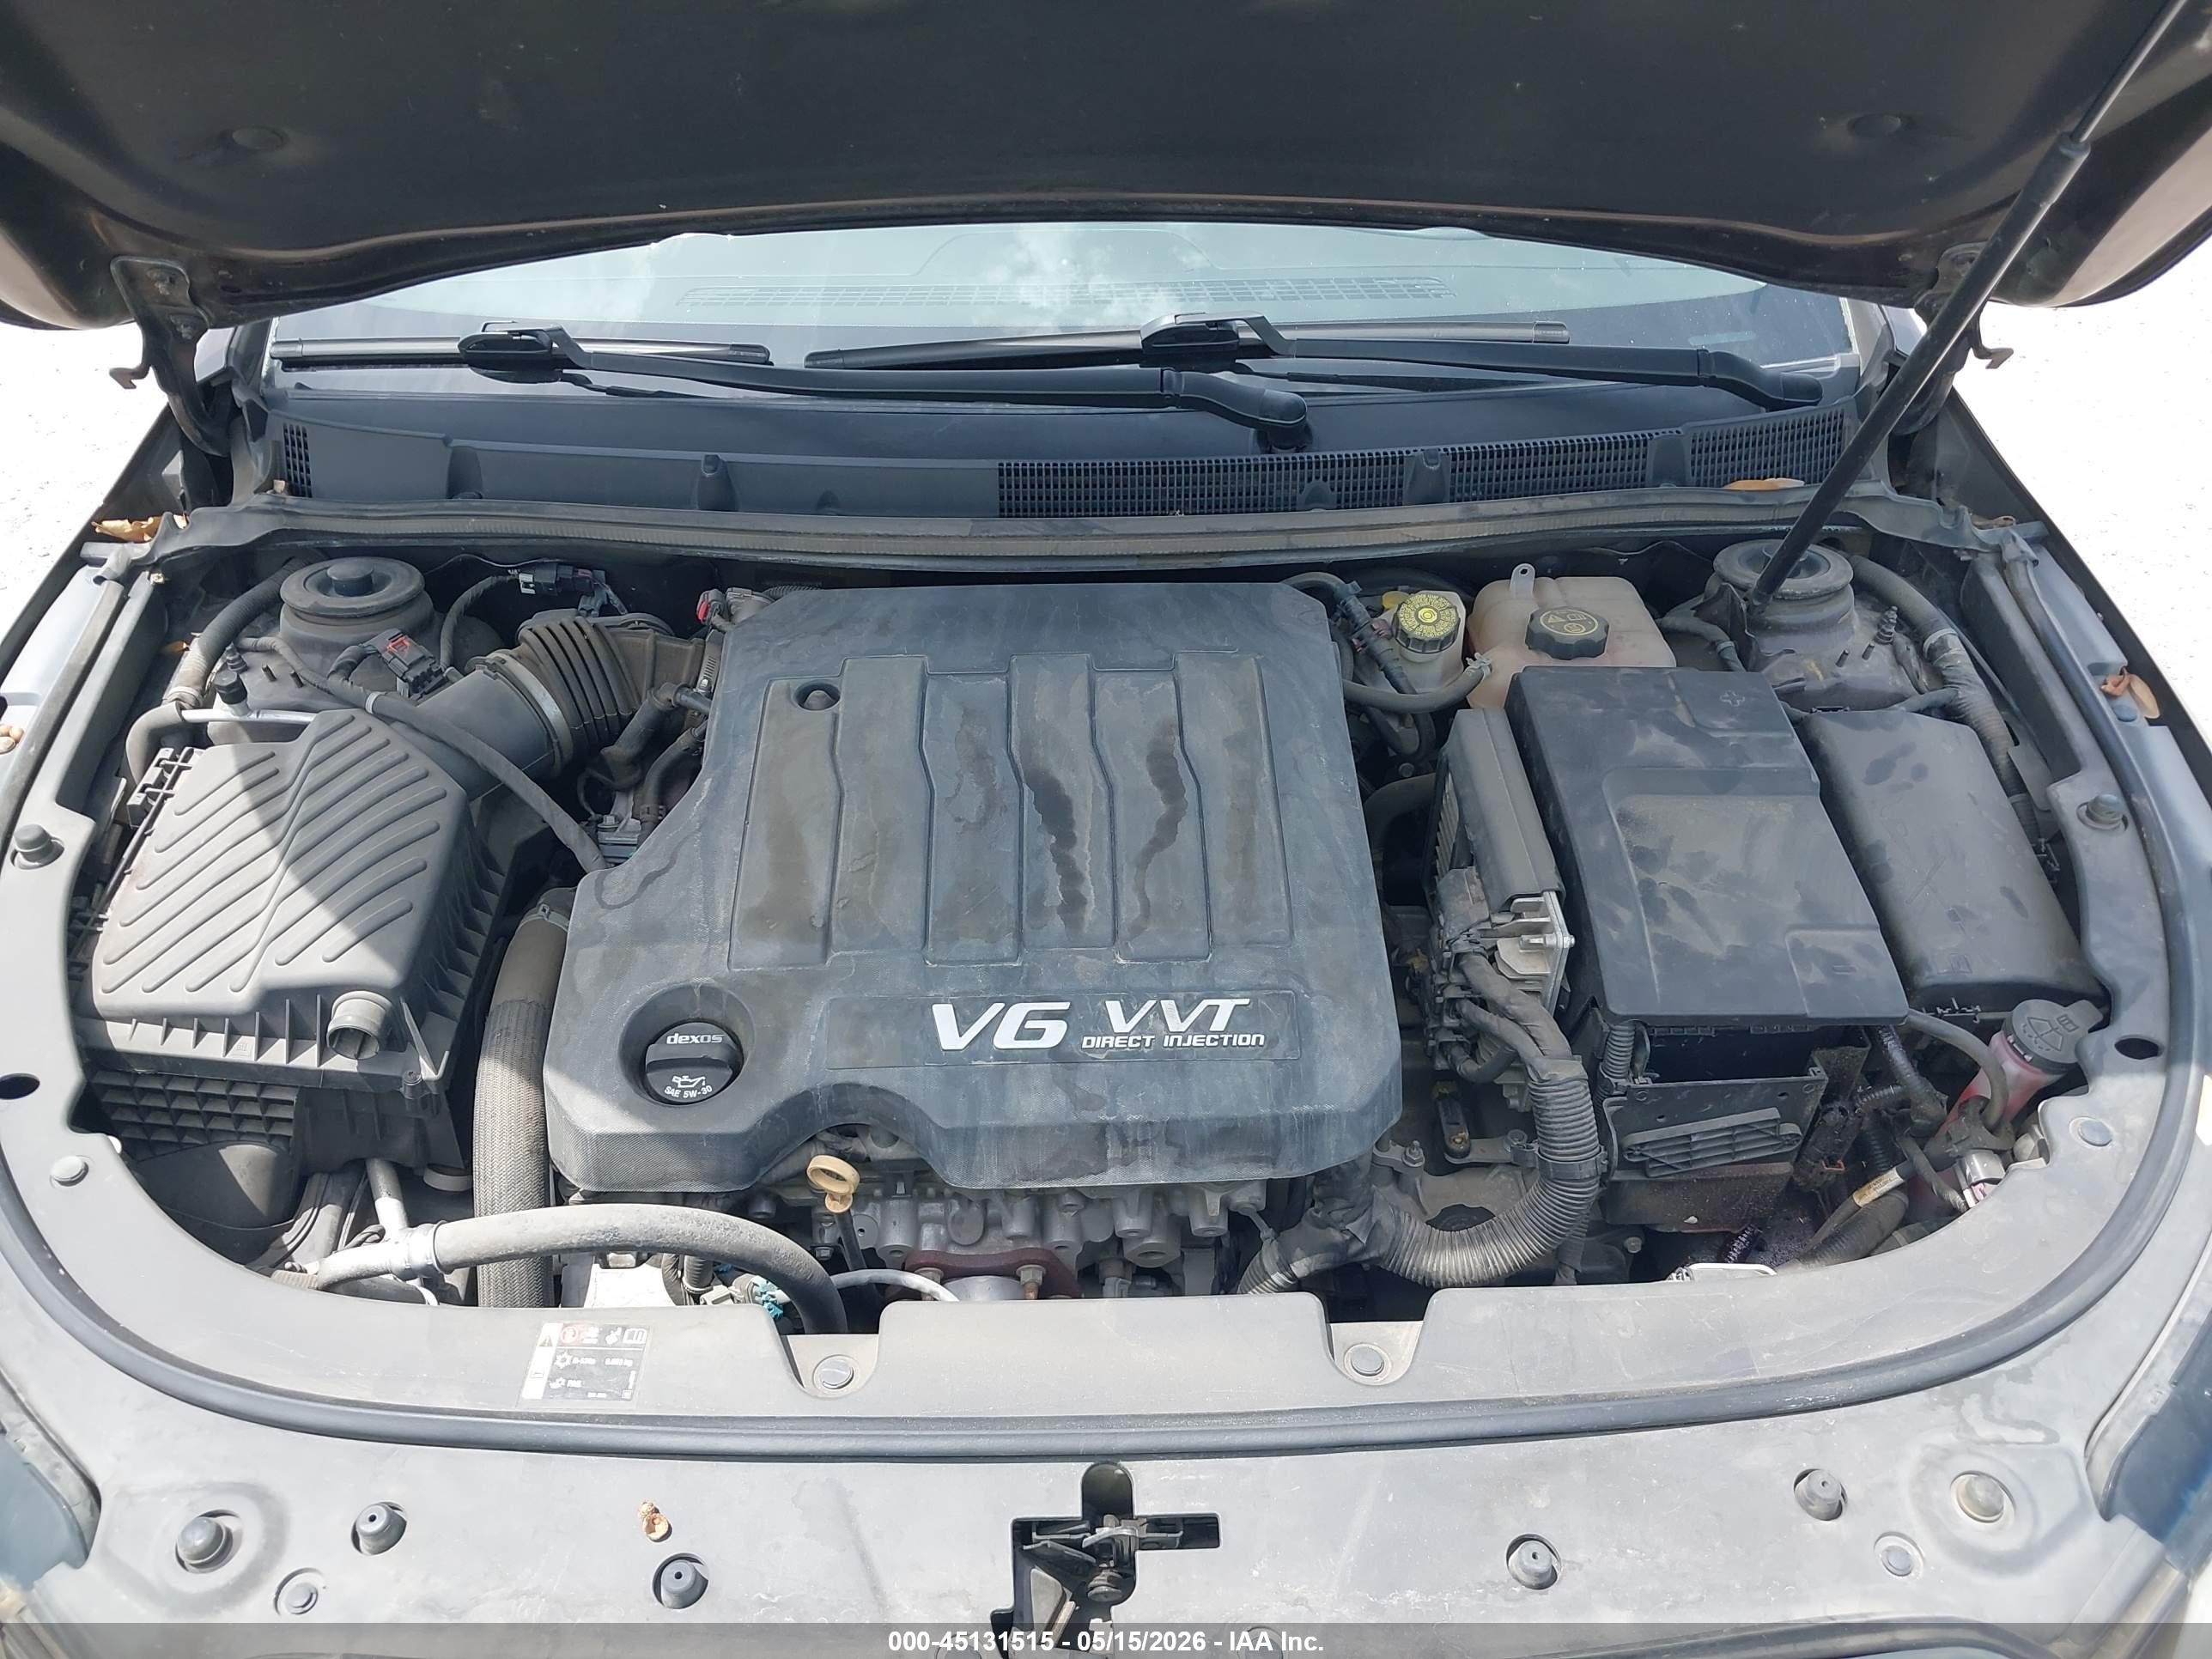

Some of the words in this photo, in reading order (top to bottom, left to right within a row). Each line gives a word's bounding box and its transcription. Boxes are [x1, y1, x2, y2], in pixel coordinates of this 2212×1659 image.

[932, 1000, 1072, 1051] V6
[1104, 998, 1250, 1033] VVT
[666, 1033, 725, 1044] dexos
[1081, 1034, 1156, 1049] DIRECT
[1163, 1033, 1265, 1048] INJECTION
[664, 1085, 682, 1098] SAE
[683, 1085, 713, 1099] 5W-30
